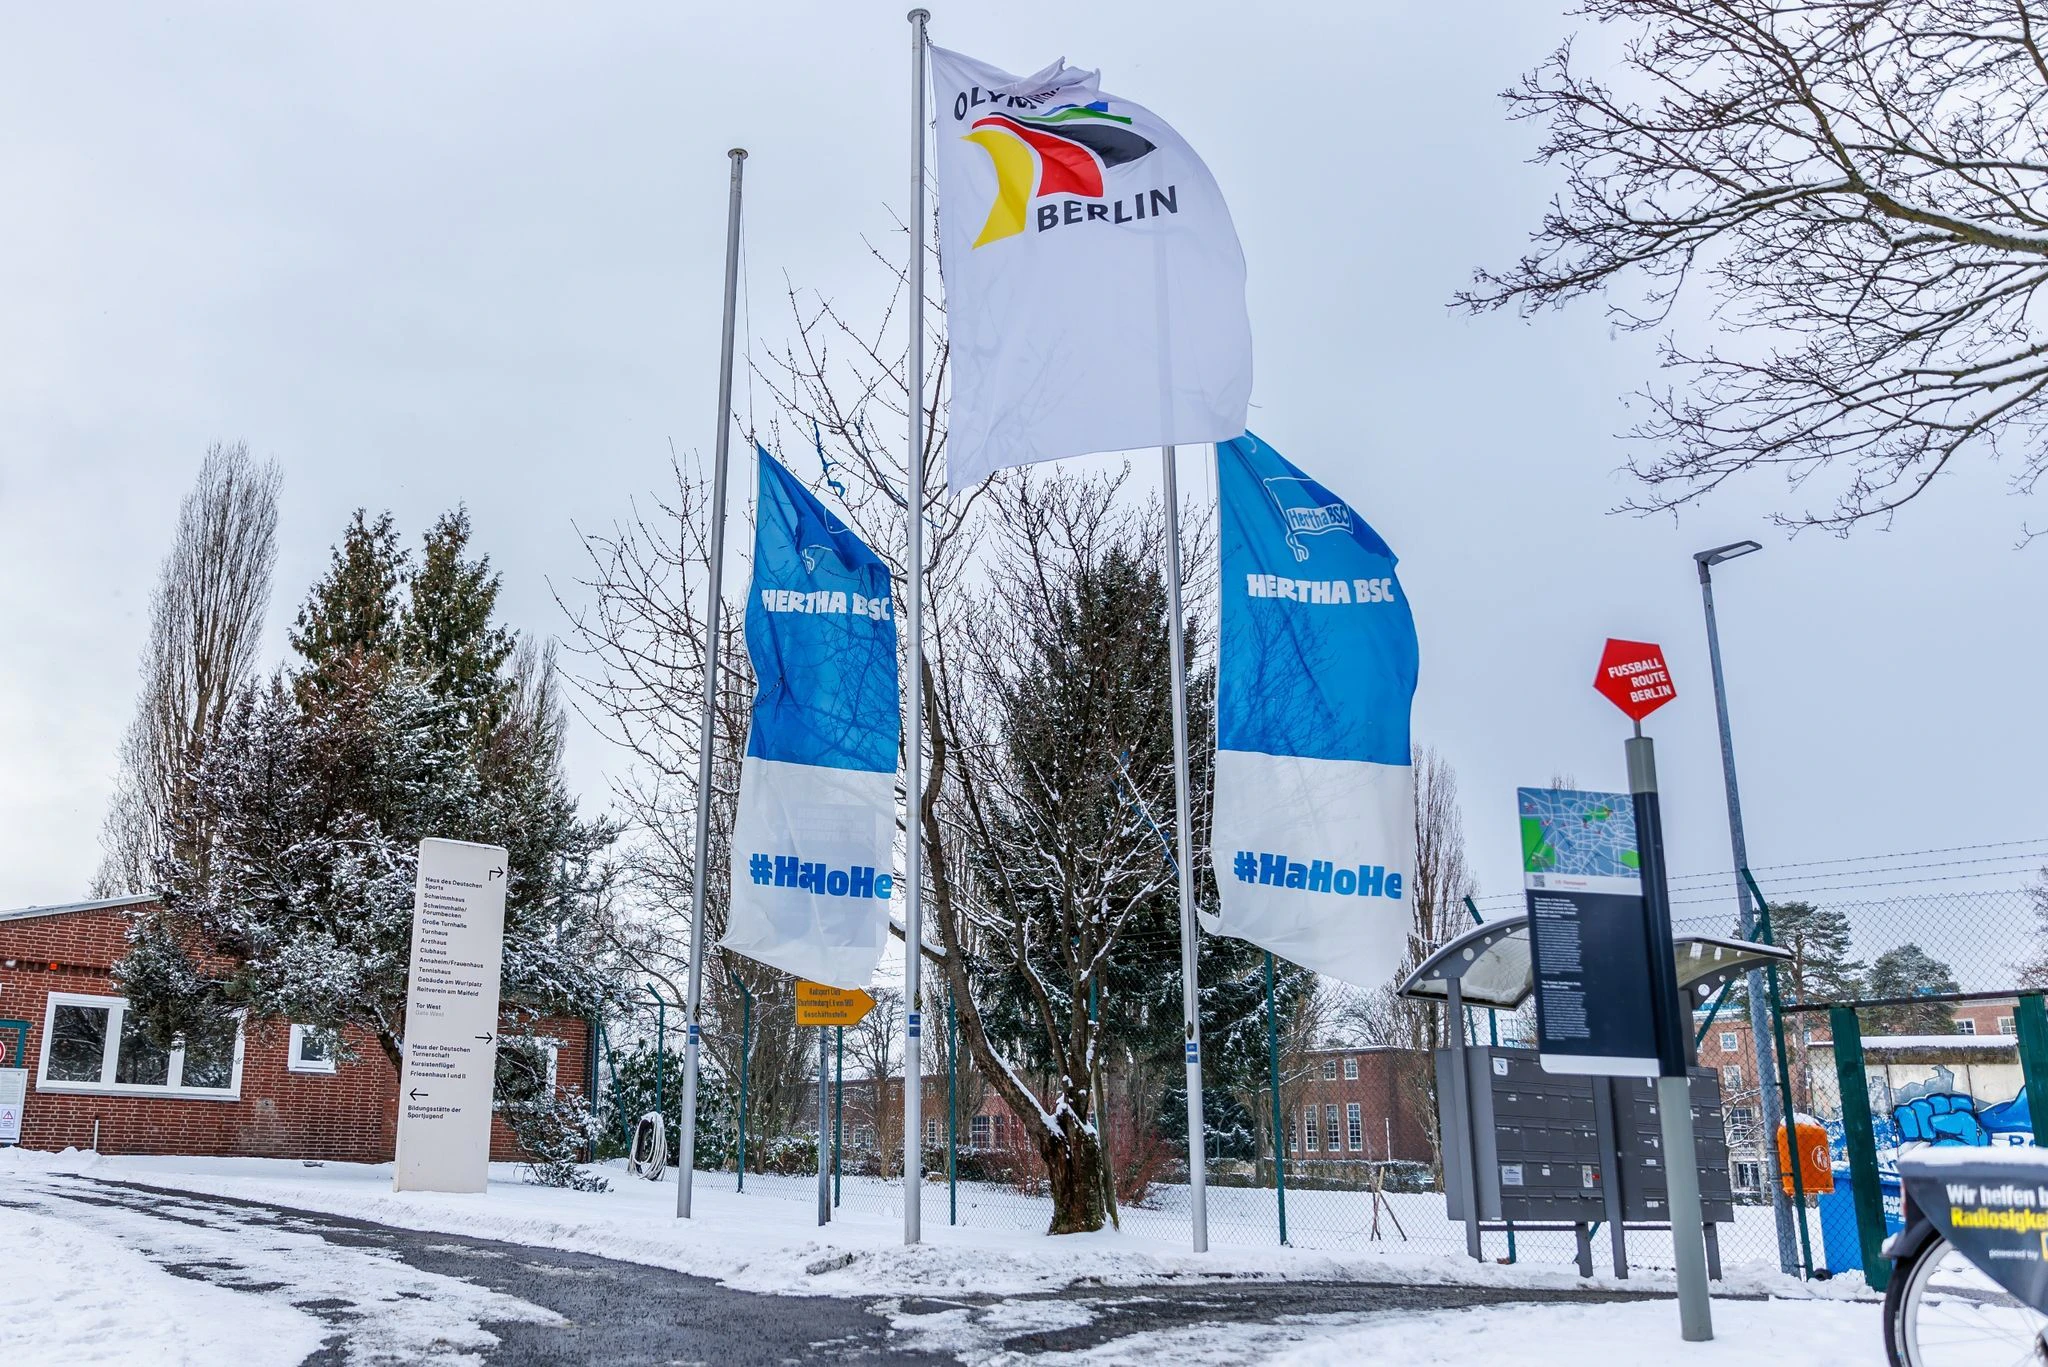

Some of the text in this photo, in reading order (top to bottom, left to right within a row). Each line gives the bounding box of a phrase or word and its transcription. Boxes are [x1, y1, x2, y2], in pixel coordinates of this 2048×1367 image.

[1037, 185, 1178, 233] BERLIN
[1288, 510, 1329, 529] Hertha
[1247, 573, 1395, 604] HERTHA BSC
[762, 589, 891, 621] HERTHA BSC
[1608, 658, 1662, 678] FUSSBALL
[1631, 671, 1667, 687] ROUTE
[1630, 685, 1672, 703] BERLIN
[1234, 851, 1402, 899] #HaHoHe
[424, 883, 444, 891] Sports
[425, 876, 440, 884] Haus
[452, 880, 483, 889] Deutschen
[424, 893, 465, 903] Schwimmhaus
[424, 902, 468, 912] Schwimmhalle/
[423, 910, 462, 919] Forumbecken
[441, 920, 467, 928] Turnhalle
[422, 928, 448, 936] Turnhaus
[420, 938, 447, 946] Arzthaus
[420, 948, 447, 956] Clubhaus
[419, 957, 484, 968] Annaheim/Frauenhaus
[419, 967, 451, 975] Tennishaus
[418, 976, 444, 984] Gebäude
[455, 979, 482, 988] Wurfplatz
[416, 986, 446, 994] Reitverein
[440, 1045, 471, 1053] Deutschen
[408, 1105, 450, 1113] Bildungsstätte
[408, 1112, 444, 1120] Sportjugend
[1946, 1184, 1978, 1205] Wir
[1980, 1185, 2036, 1207] helfen
[1951, 1207, 2048, 1234] Radlosigke
[1989, 1249, 2039, 1261] powered by
